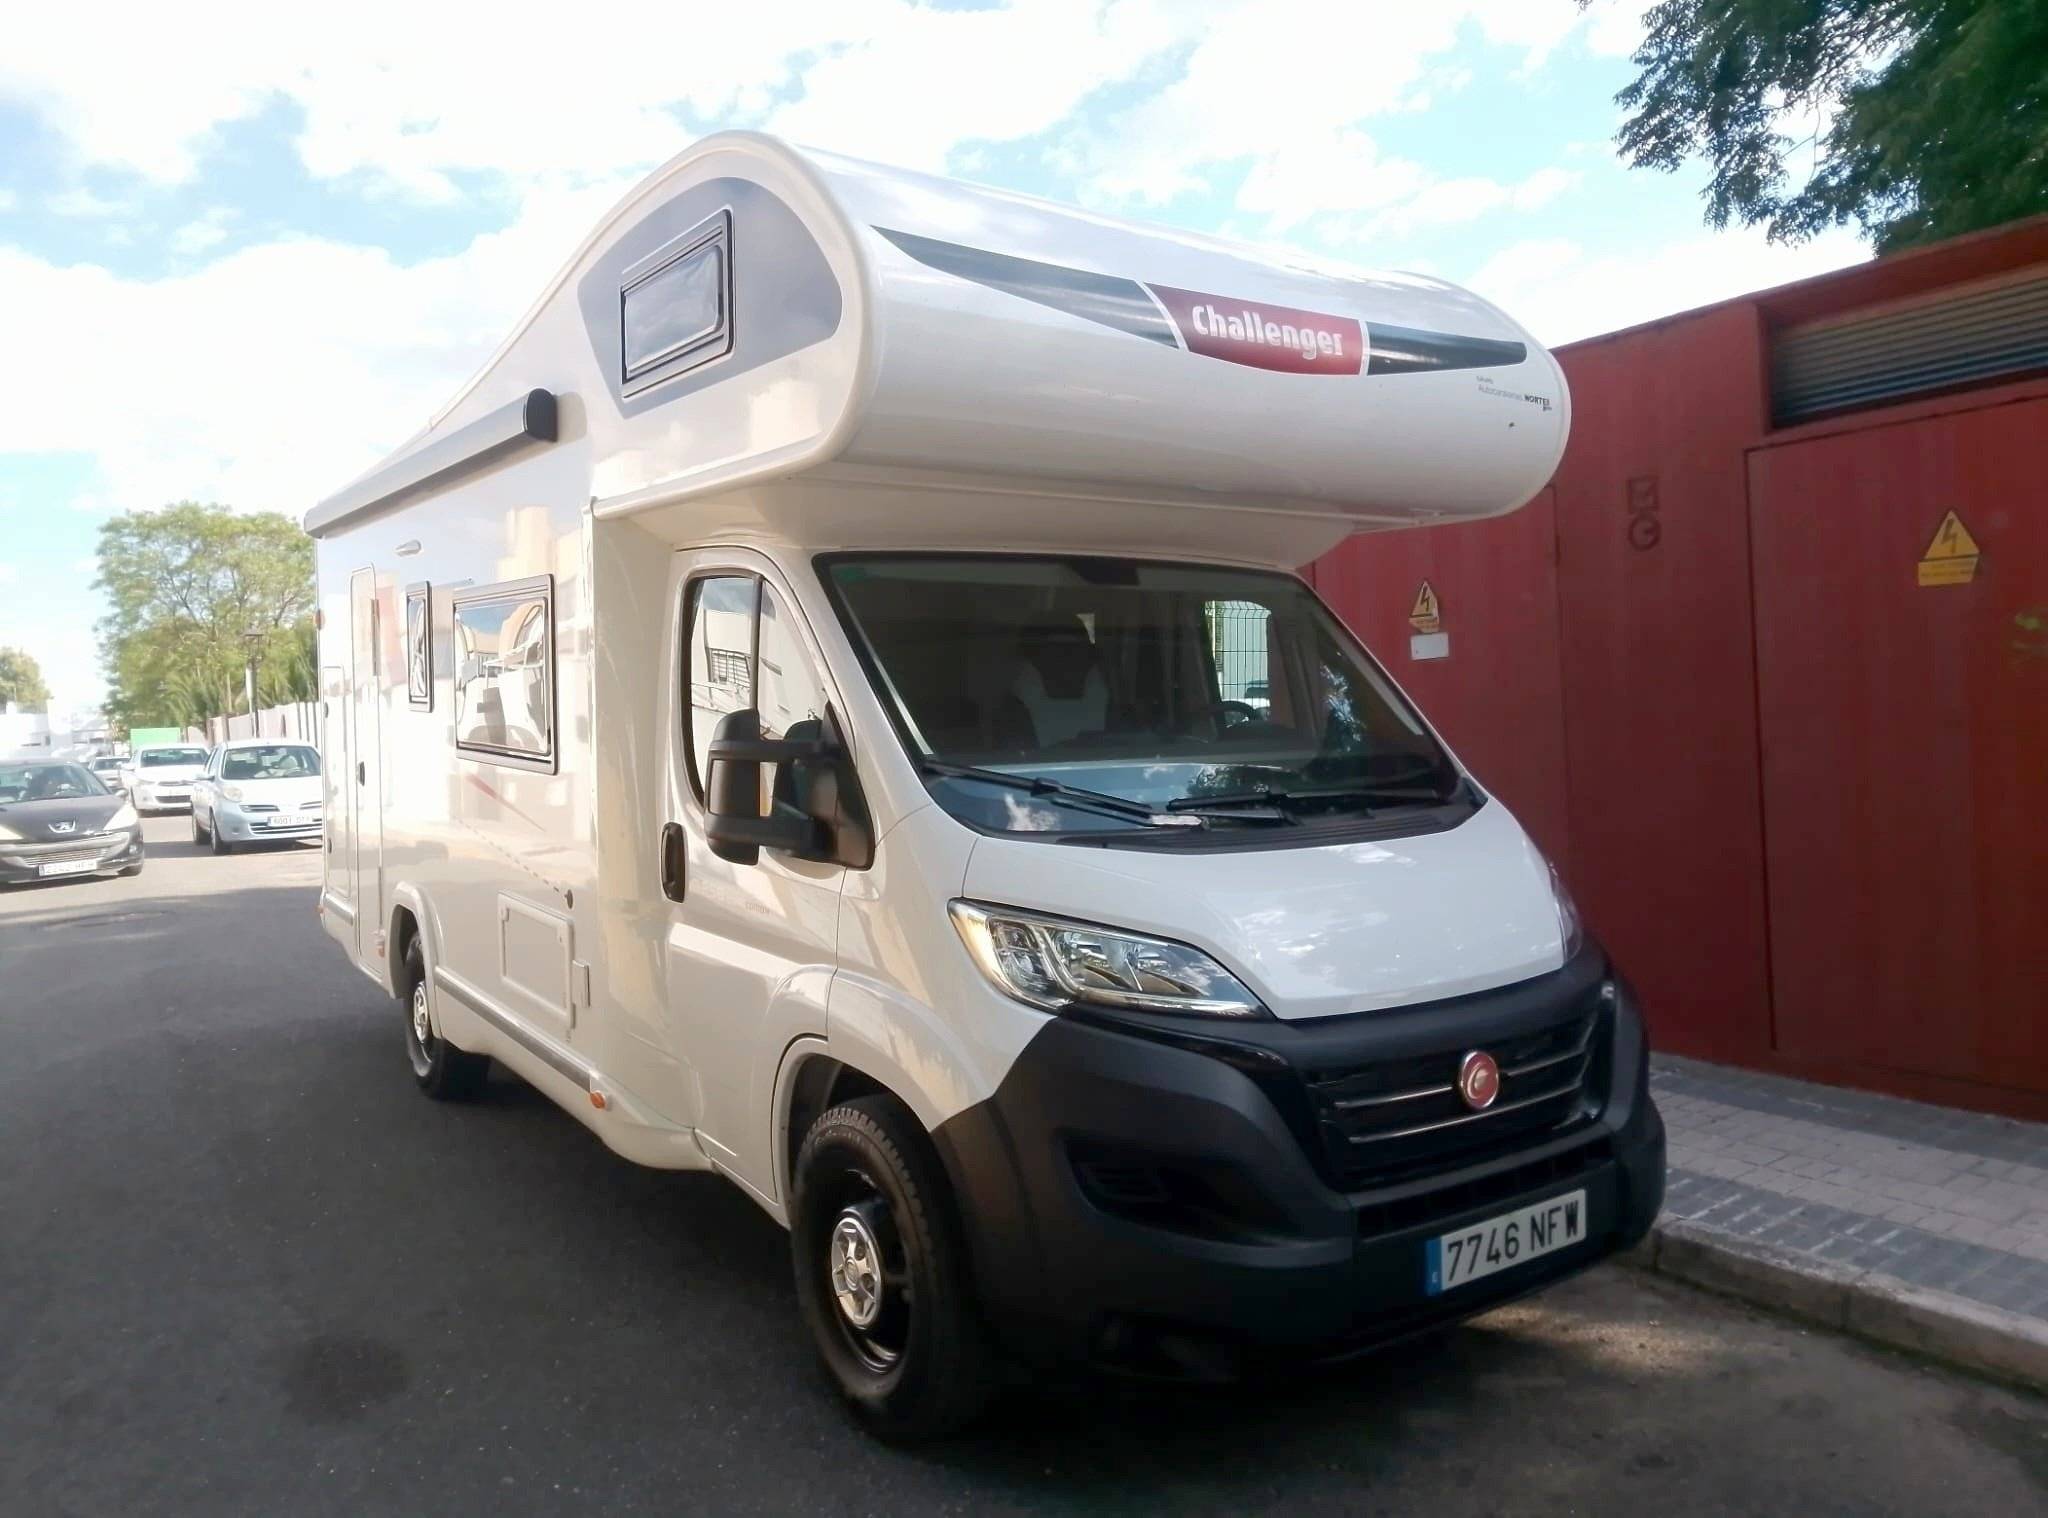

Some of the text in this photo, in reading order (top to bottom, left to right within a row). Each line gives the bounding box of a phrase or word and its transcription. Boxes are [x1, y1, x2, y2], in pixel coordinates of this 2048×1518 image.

[1192, 304, 1344, 360] Challenger
[1447, 1200, 1579, 1282] 7746 NFW
